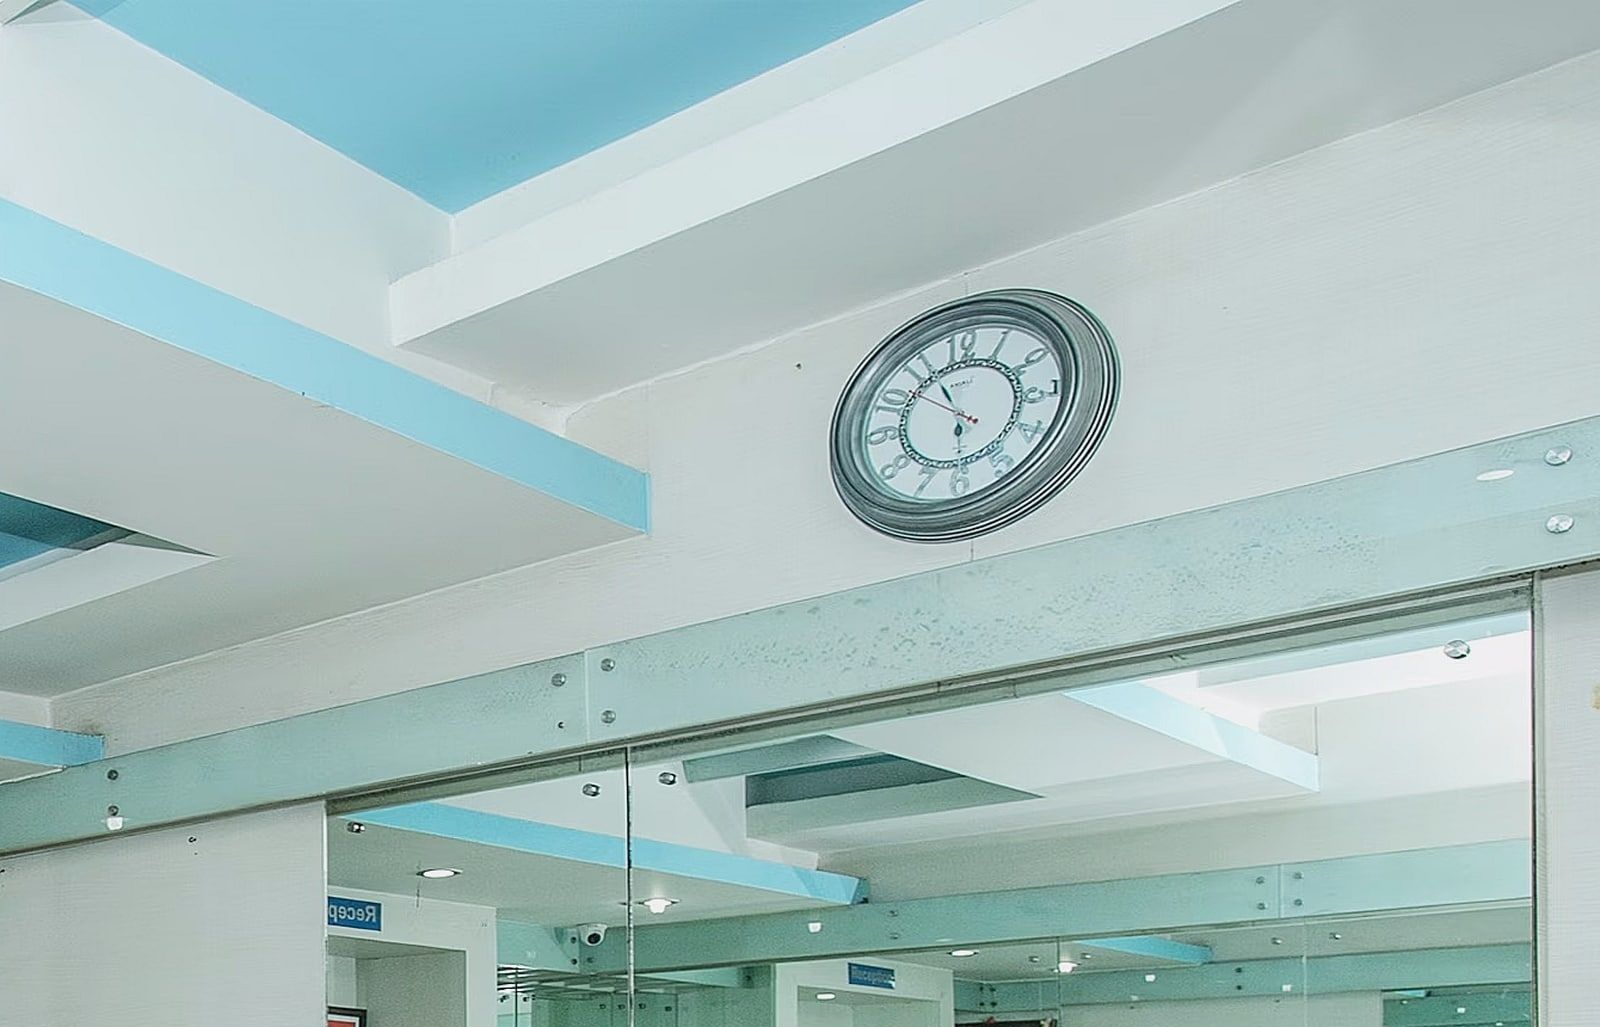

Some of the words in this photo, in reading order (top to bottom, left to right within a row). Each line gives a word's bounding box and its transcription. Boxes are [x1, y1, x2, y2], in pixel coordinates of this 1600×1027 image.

[946, 329, 978, 364] 12
[988, 329, 1011, 361] 1
[1012, 347, 1050, 376] 2
[874, 388, 910, 415] 10
[866, 426, 900, 446] 9
[1016, 419, 1046, 444] 4
[880, 453, 912, 480] 8
[988, 440, 1015, 478] 5
[913, 466, 940, 498] 7
[950, 464, 970, 497] 6
